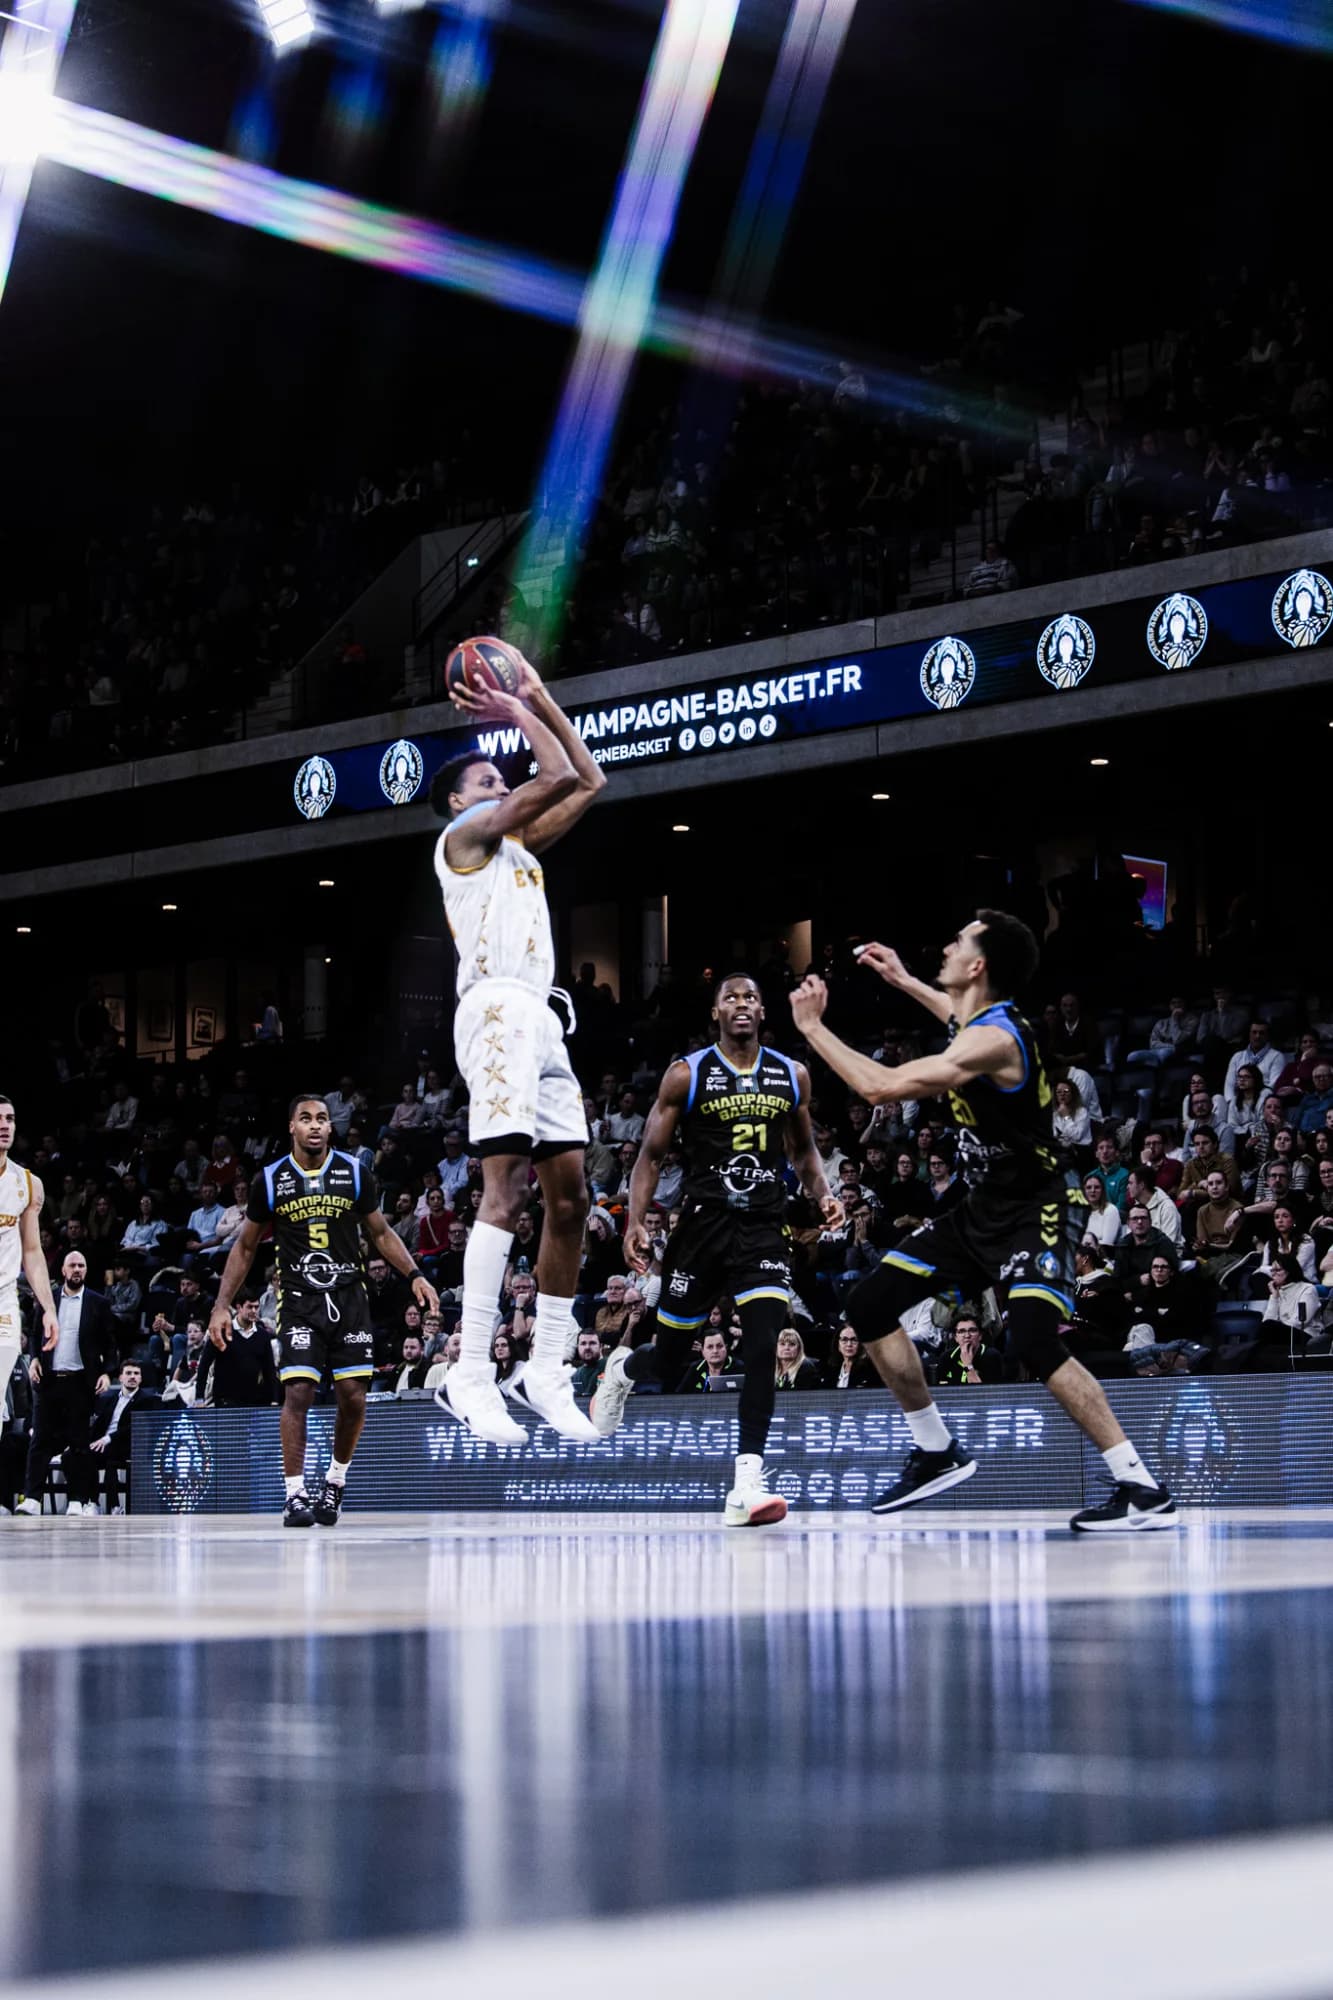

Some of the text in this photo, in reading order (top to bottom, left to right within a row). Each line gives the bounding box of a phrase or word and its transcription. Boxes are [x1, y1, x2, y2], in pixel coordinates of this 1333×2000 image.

[700, 1094, 791, 1115] CHAMPAGNE
[719, 1105, 779, 1121] BASKET
[732, 1123, 767, 1152] 21
[276, 1195, 354, 1216] CHAMPAGNE
[289, 1206, 343, 1222] BASKET
[308, 1223, 330, 1250] 5
[669, 1278, 689, 1293] ASI
[291, 1333, 311, 1347] ASI
